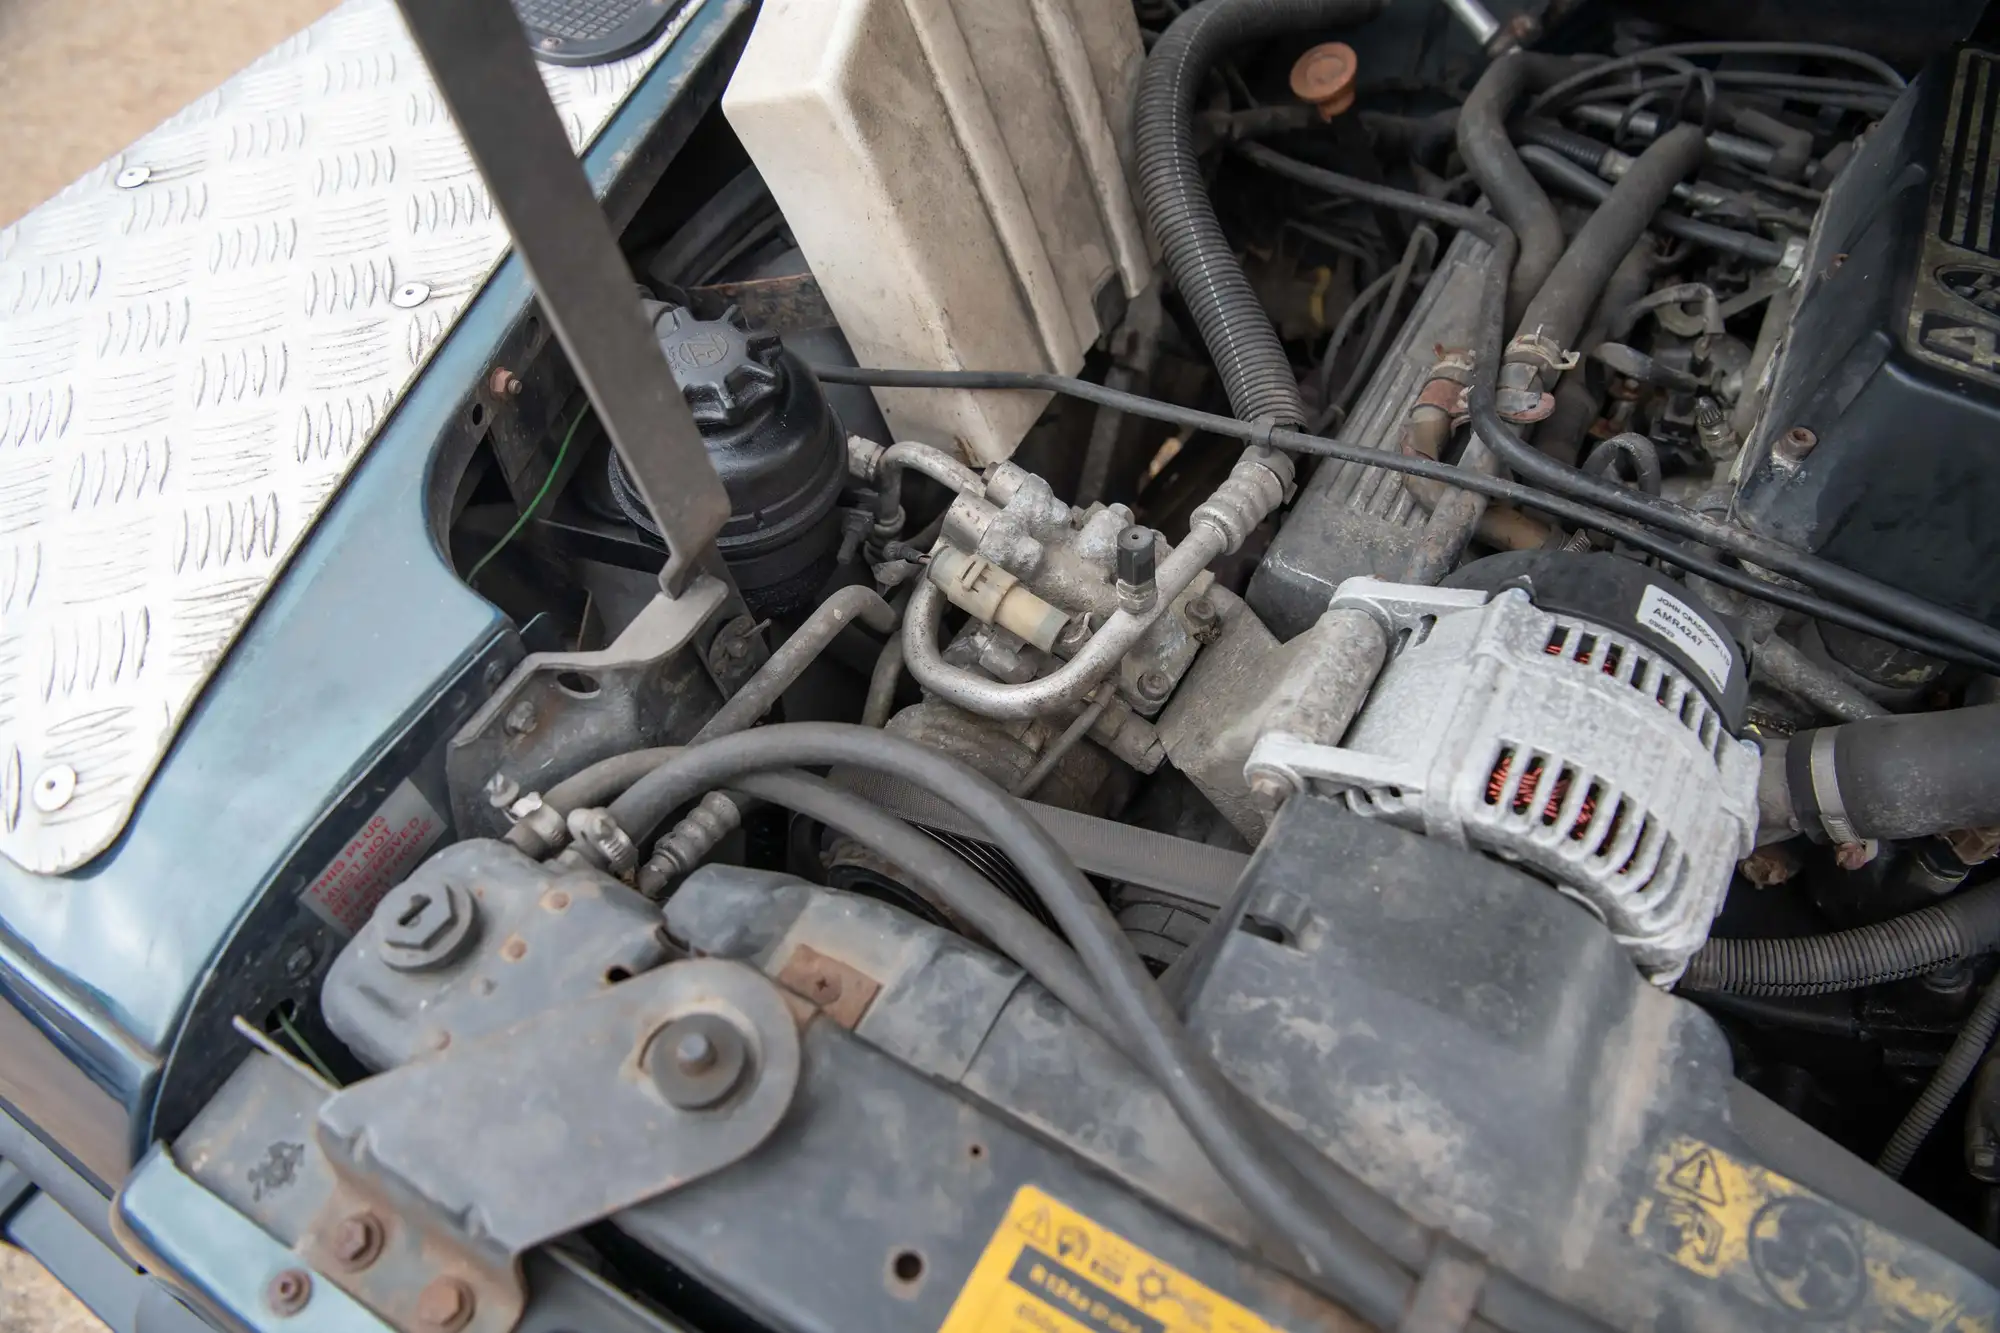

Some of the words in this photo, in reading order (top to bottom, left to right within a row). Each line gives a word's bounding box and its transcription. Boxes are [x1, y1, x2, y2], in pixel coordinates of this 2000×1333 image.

[1653, 607, 1703, 646] AMR4247
[1657, 596, 1680, 614] JOHN
[1682, 612, 1720, 649] CRADDOCK
[311, 860, 345, 895] THIS
[345, 815, 386, 858] PLUG
[320, 861, 362, 903] MUST
[363, 826, 391, 859] NOT
[331, 893, 350, 916] BE
[353, 817, 420, 891] REMOVED
[383, 819, 433, 875] ENGINE
